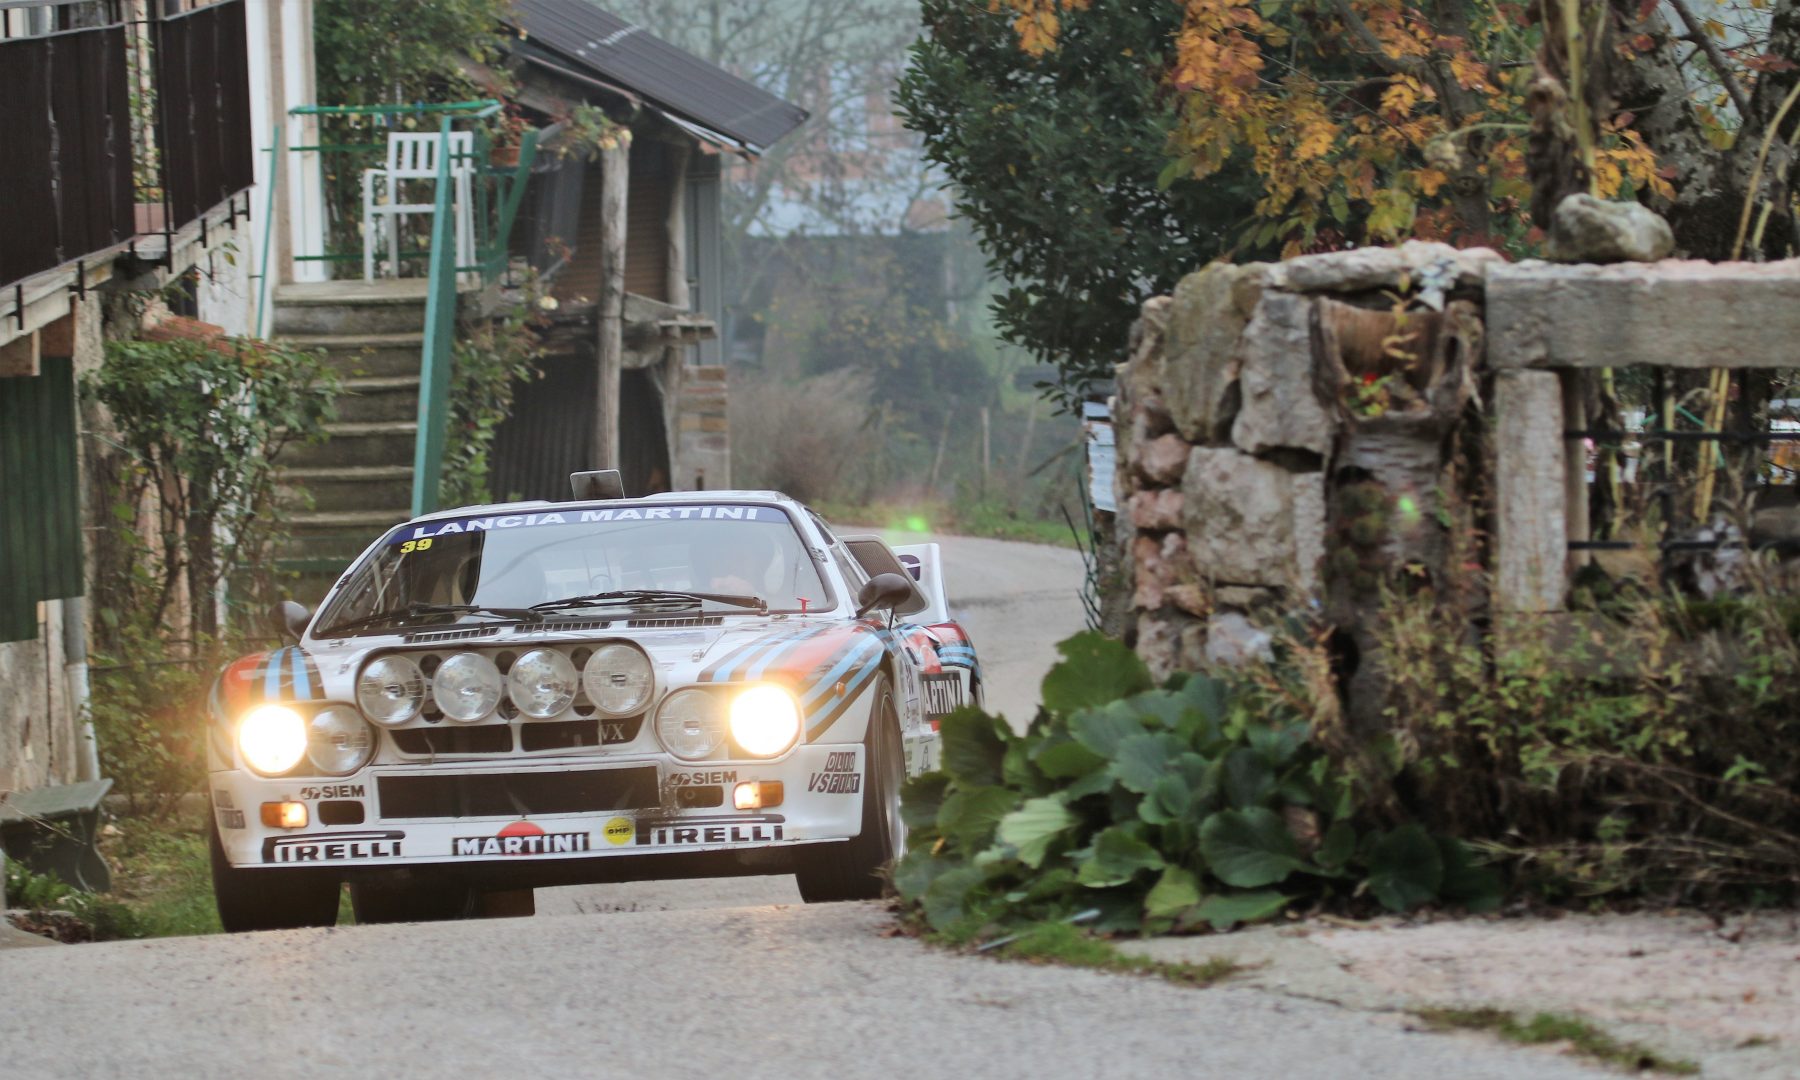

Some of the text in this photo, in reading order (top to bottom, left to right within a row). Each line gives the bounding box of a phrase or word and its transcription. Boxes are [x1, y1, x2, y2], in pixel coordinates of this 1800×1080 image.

[413, 507, 758, 539] LANCIA MARTINI
[400, 538, 433, 554] 39
[920, 680, 962, 715] ARTINI
[692, 770, 737, 785] SIEM
[322, 784, 365, 799] SIEM
[635, 813, 786, 845] PIRELLI
[261, 830, 406, 864] PIRELLI
[457, 833, 585, 855] MARTINI
